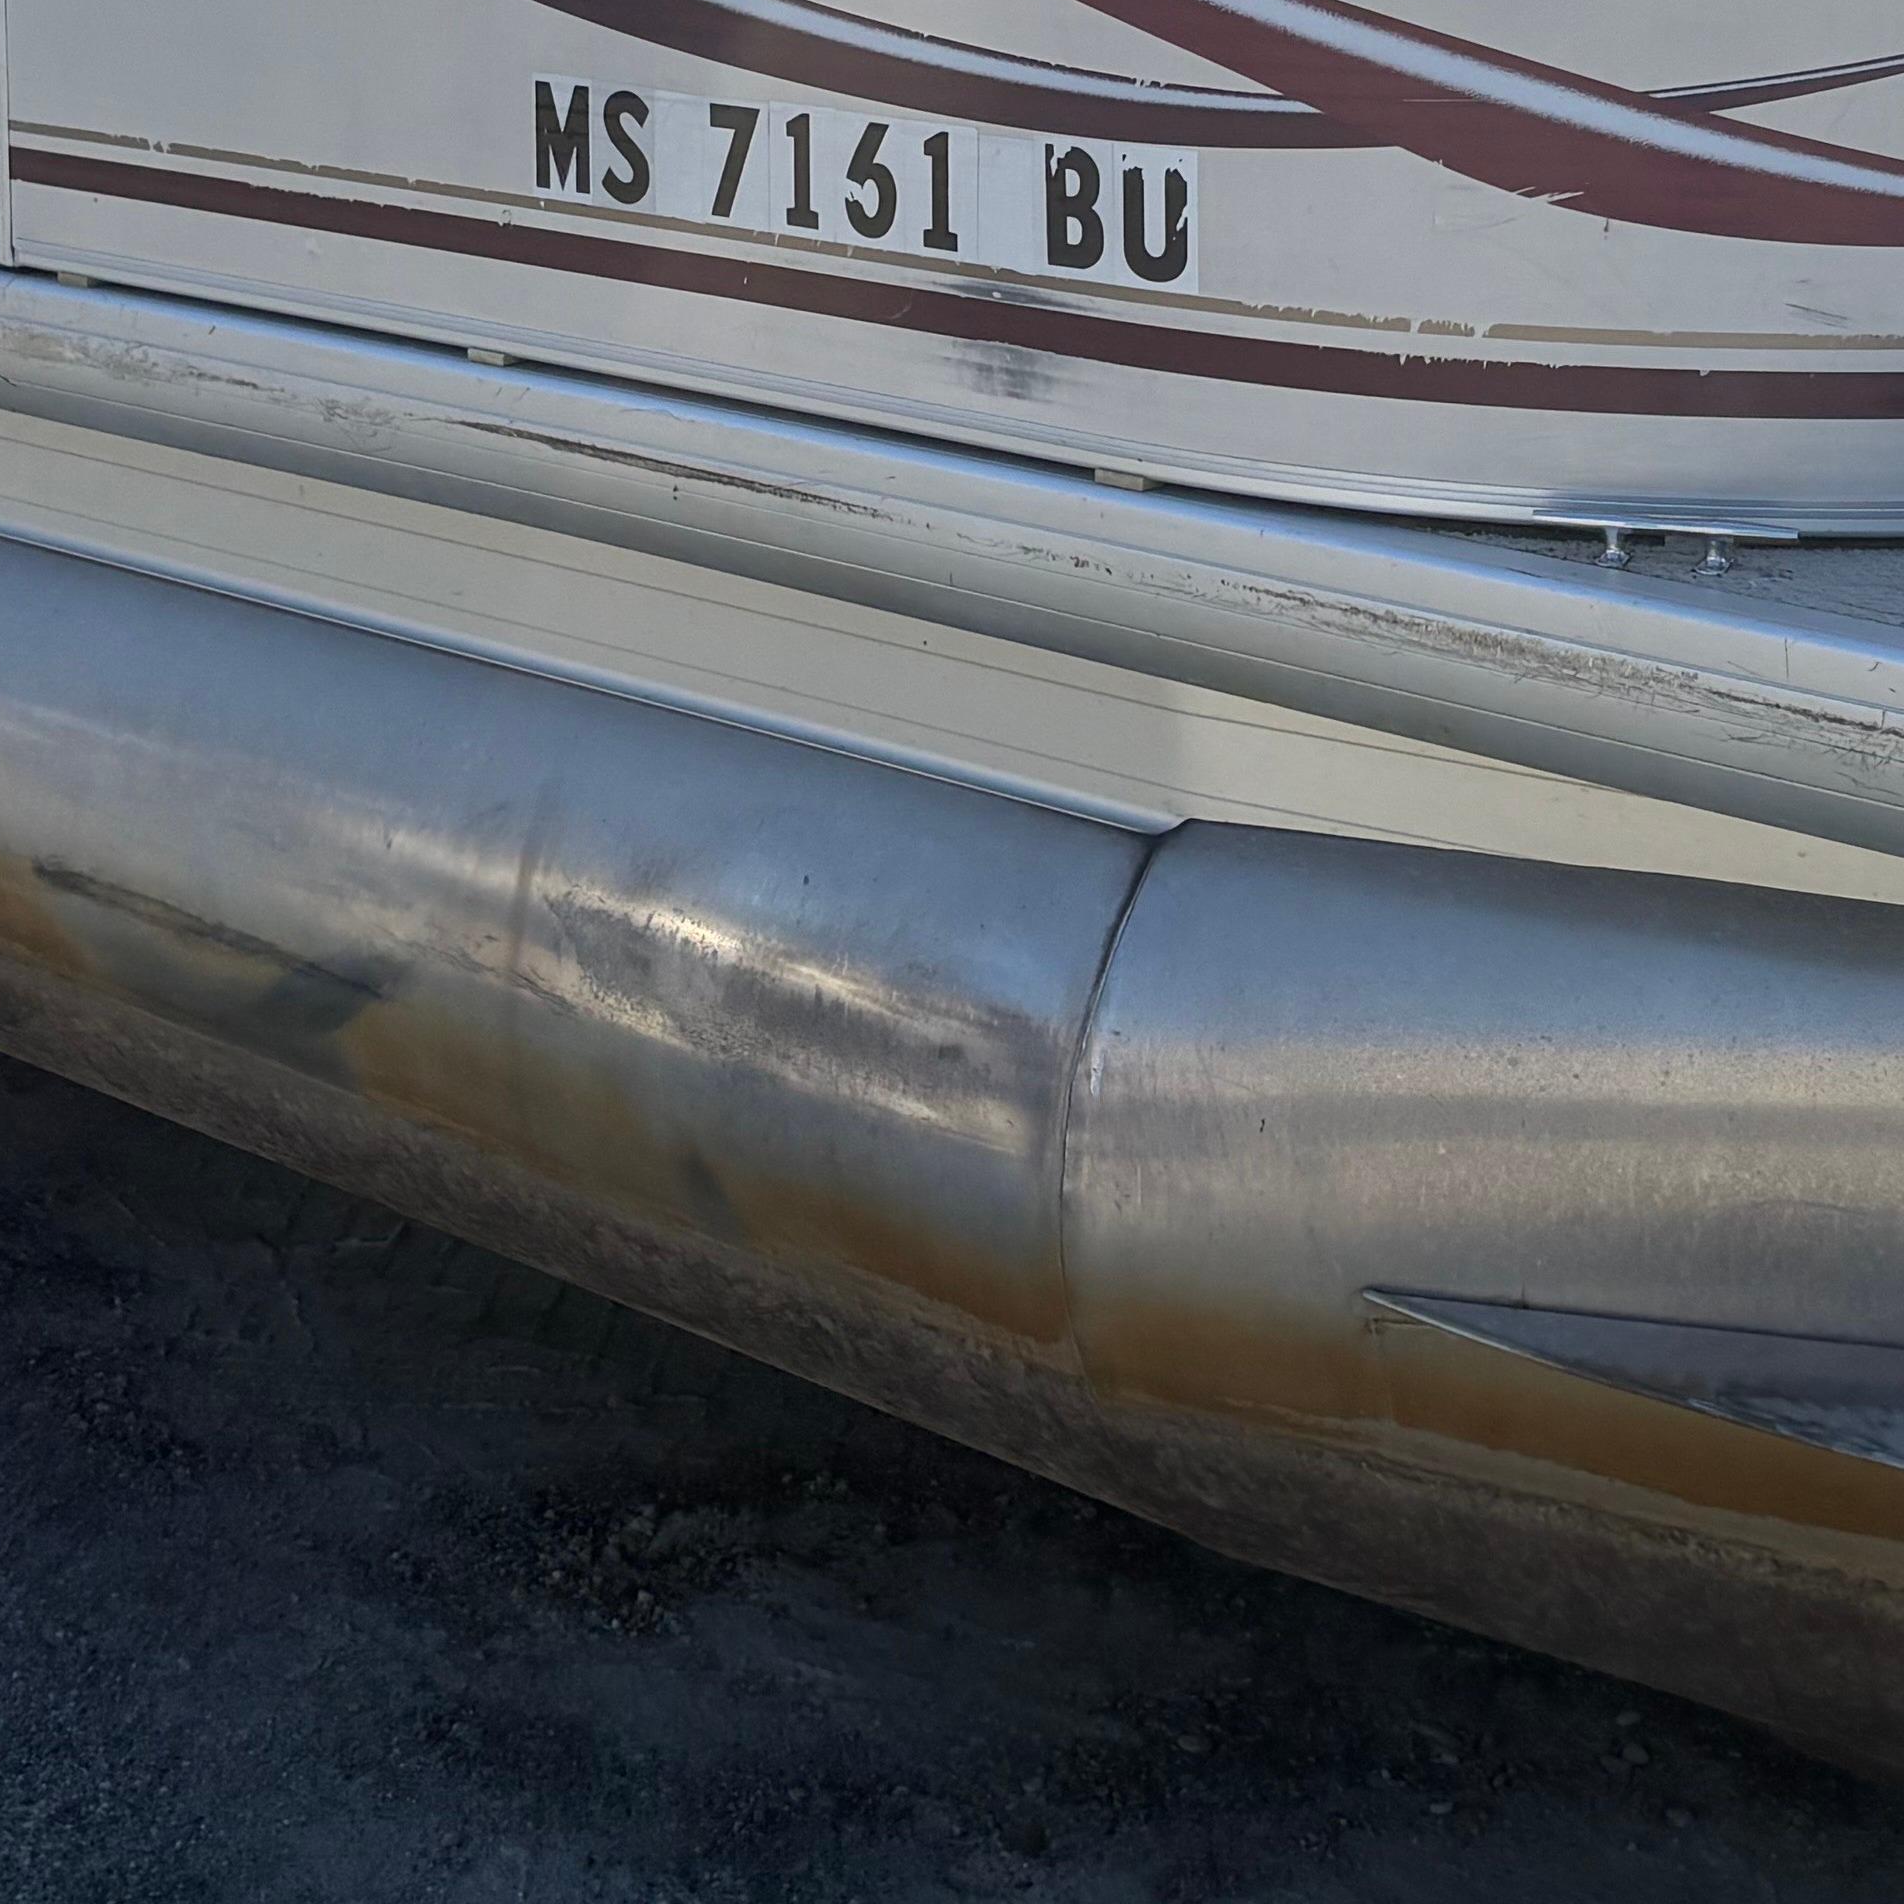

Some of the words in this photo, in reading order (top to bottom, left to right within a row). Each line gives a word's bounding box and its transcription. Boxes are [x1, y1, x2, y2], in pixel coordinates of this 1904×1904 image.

[534, 80, 650, 206] MS
[708, 102, 959, 253] 7161
[1044, 142, 1189, 284] BU
